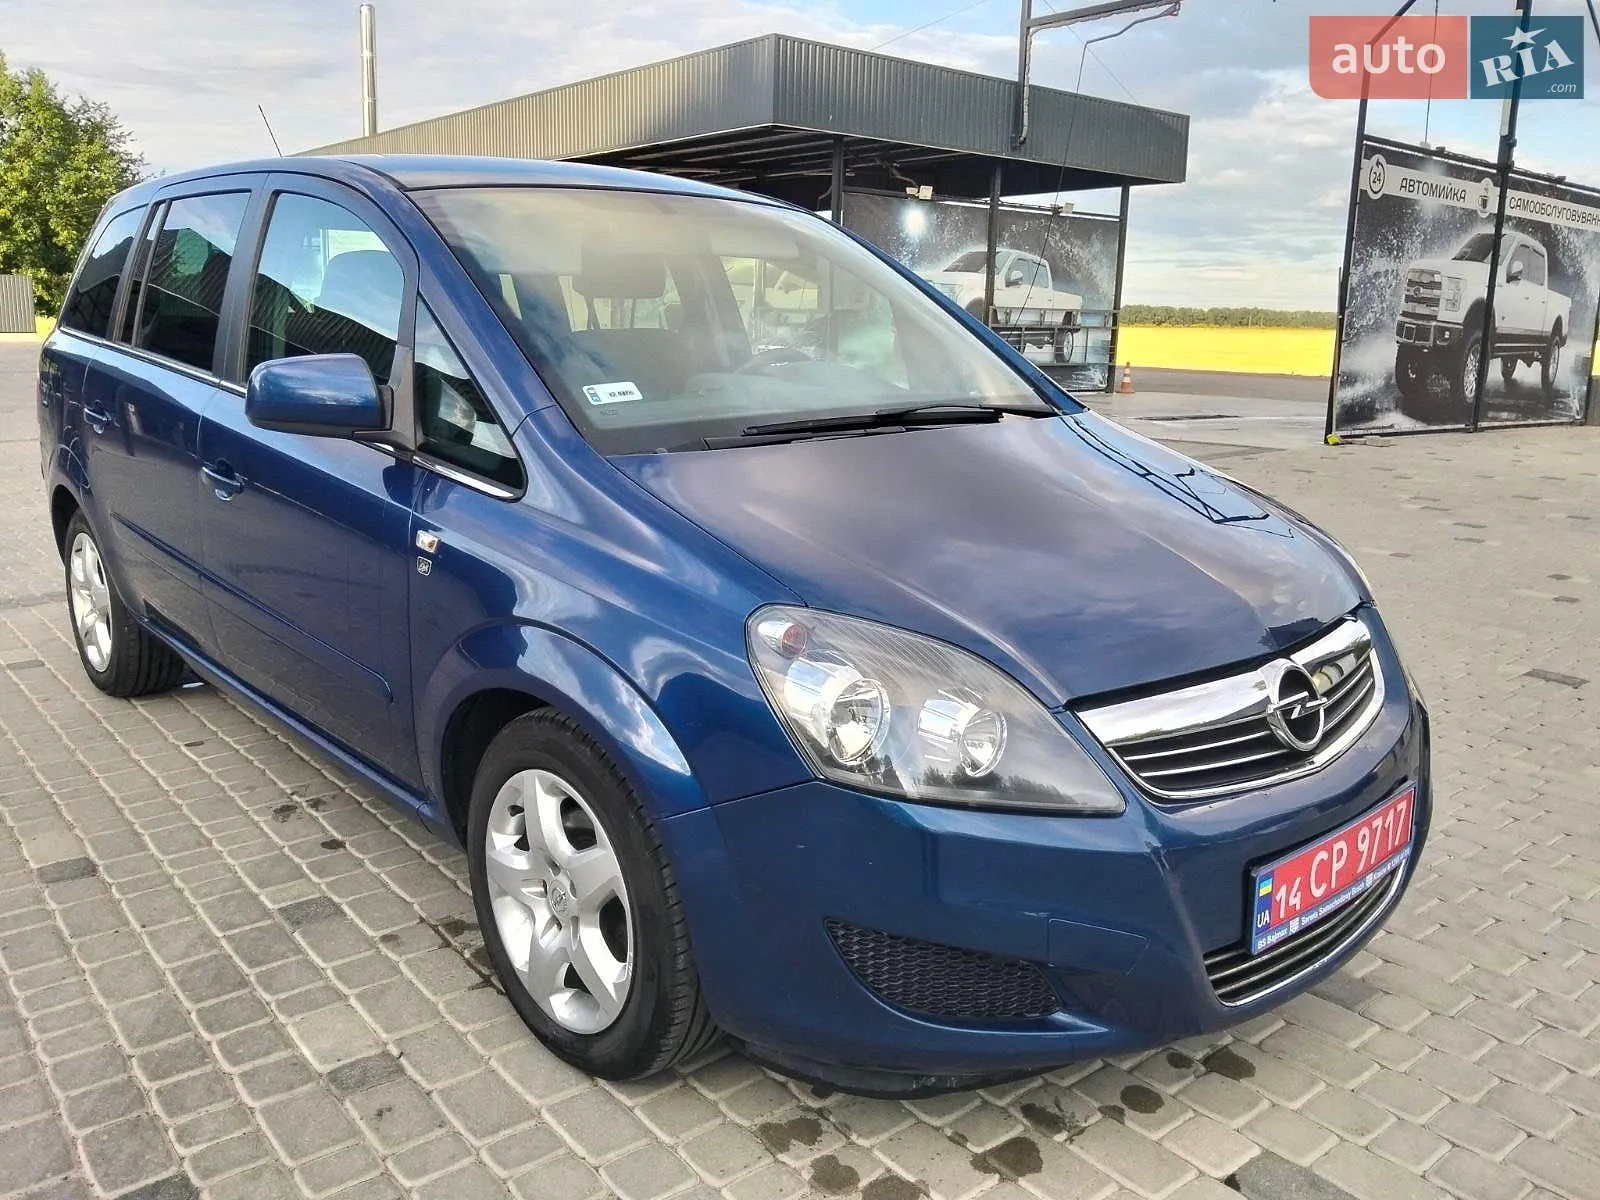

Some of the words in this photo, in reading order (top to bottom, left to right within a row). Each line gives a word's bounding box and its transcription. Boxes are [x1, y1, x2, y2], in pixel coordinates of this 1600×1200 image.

[1372, 171, 1382, 185] 24
[1399, 177, 1467, 202] АВТОМИЙКА
[1275, 876, 1302, 919] 14
[1356, 800, 1407, 874] 9717
[1257, 909, 1270, 928] UA
